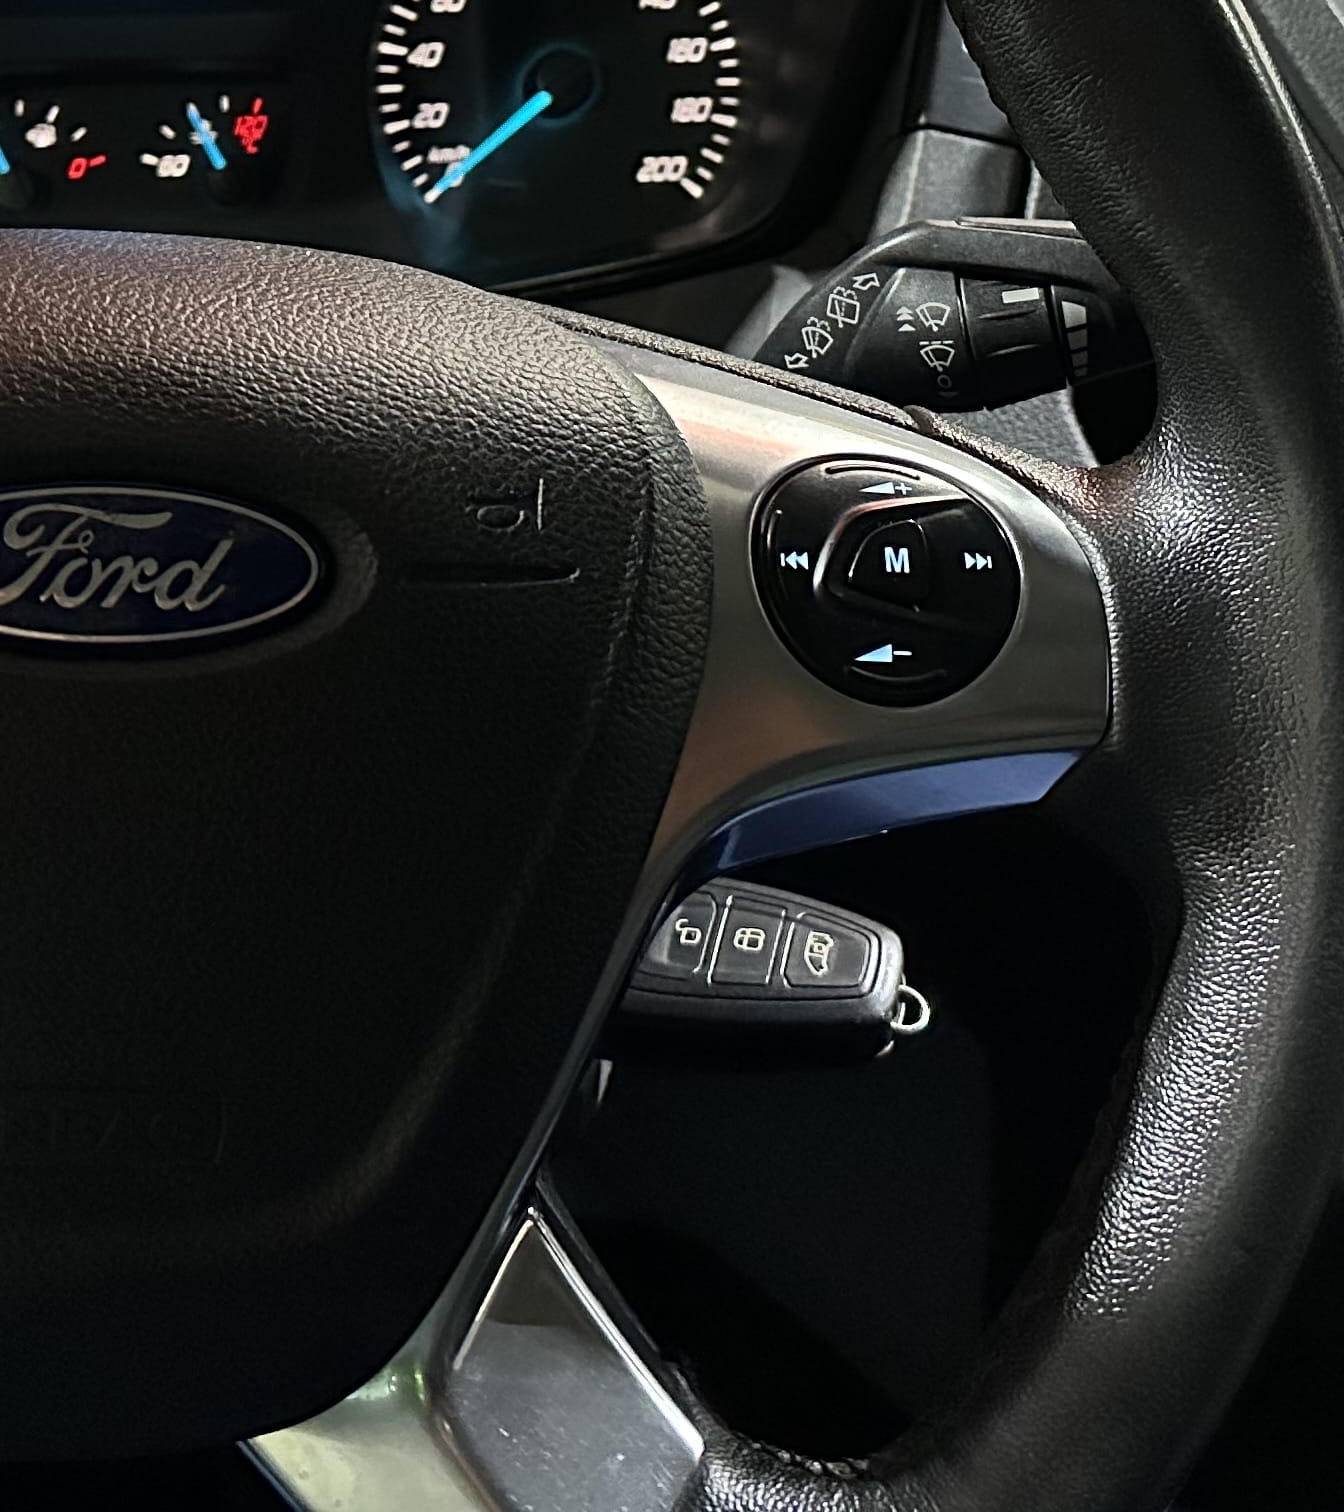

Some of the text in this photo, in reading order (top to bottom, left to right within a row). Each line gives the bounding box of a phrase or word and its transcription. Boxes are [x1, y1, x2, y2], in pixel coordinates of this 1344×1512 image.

[407, 41, 446, 69] 40
[411, 102, 451, 130] 20
[635, 156, 689, 184] 200
[884, 546, 911, 574] M
